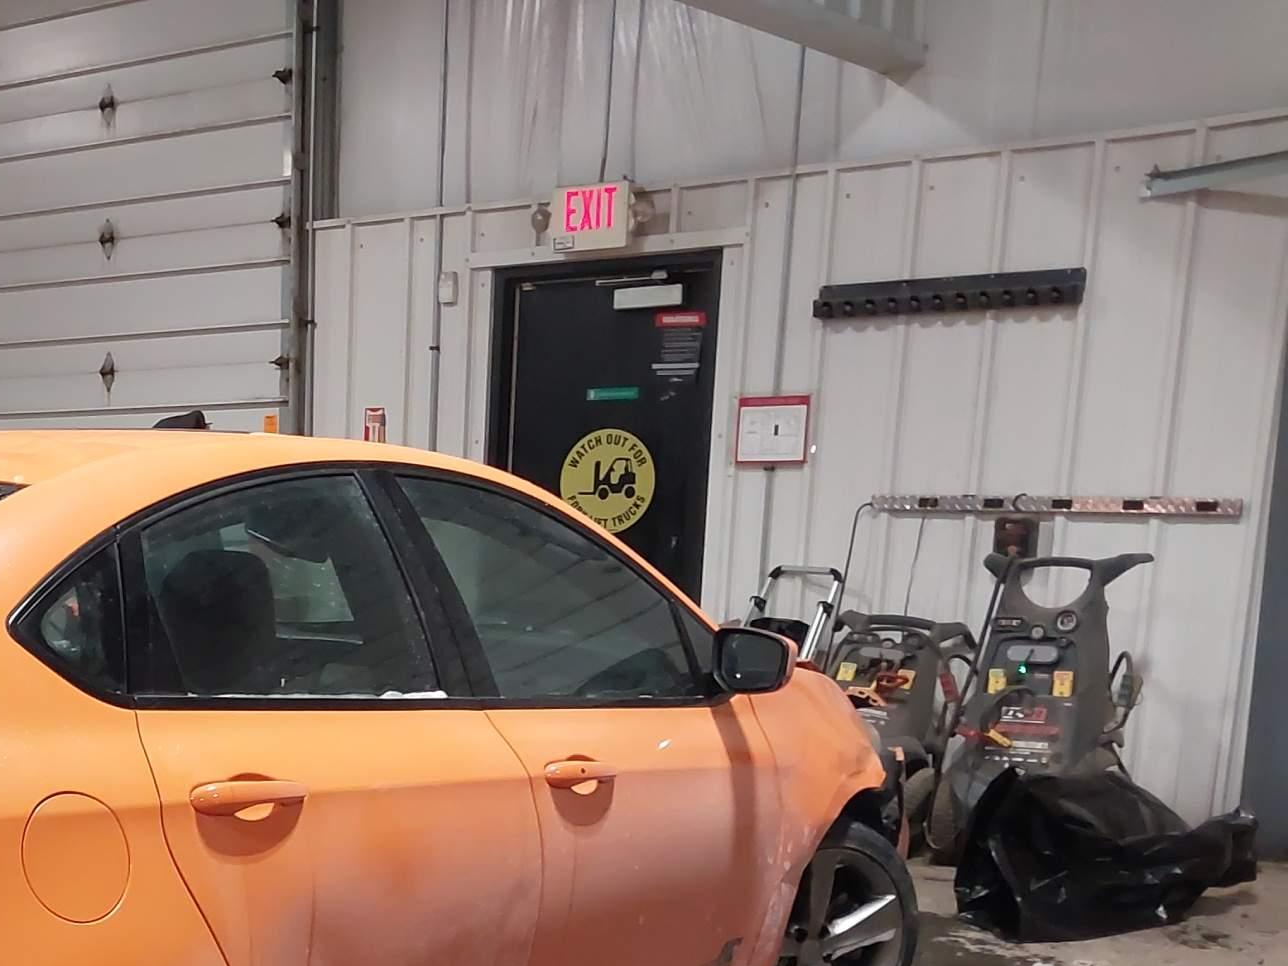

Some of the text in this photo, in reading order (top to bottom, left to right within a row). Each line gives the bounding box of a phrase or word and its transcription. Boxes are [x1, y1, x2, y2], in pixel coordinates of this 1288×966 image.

[566, 187, 616, 232] EXIT
[568, 434, 648, 468] WATCH OUT FOR
[611, 496, 646, 527] TRUCKS
